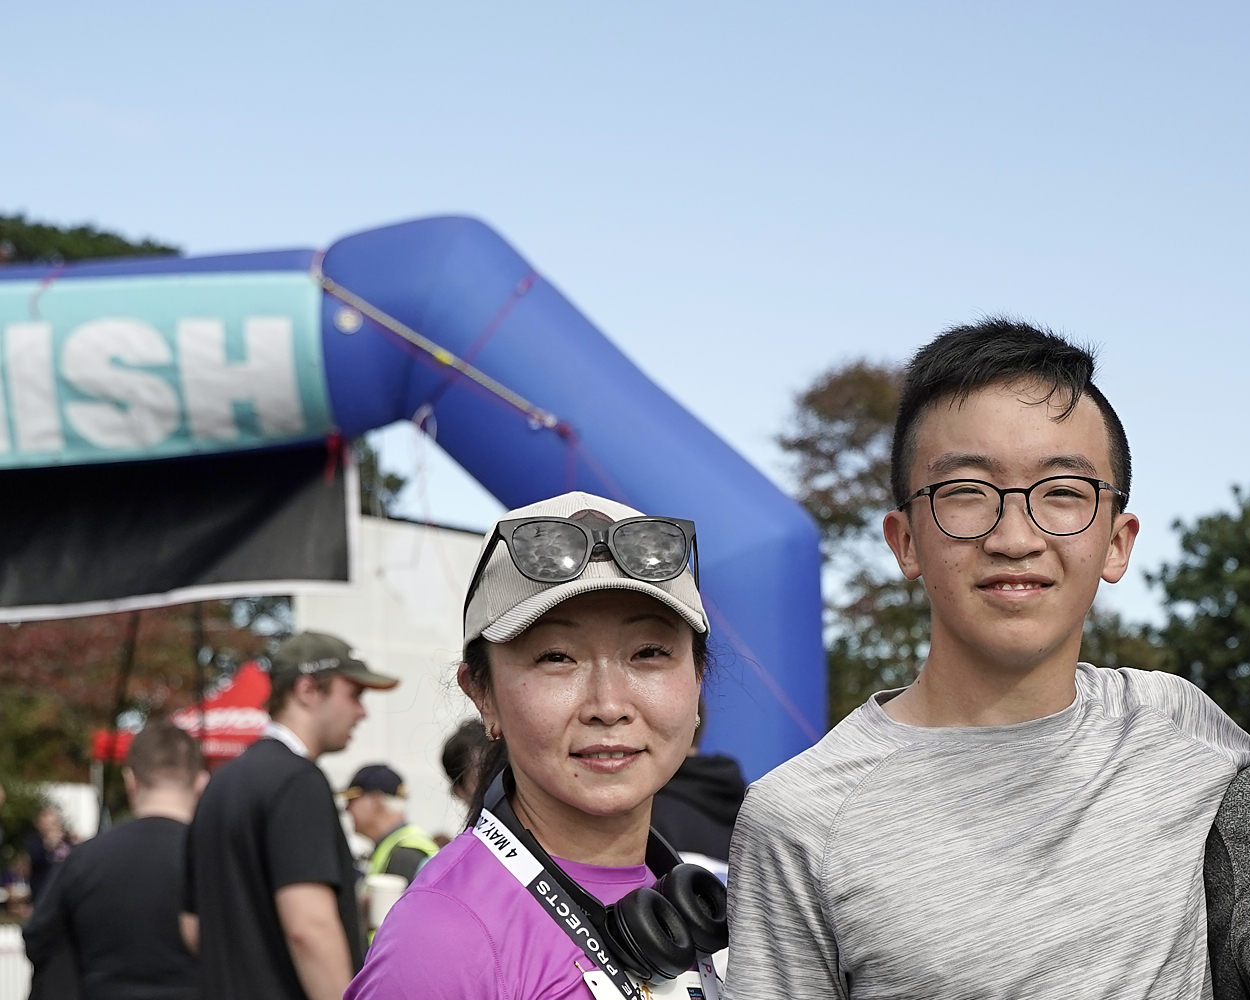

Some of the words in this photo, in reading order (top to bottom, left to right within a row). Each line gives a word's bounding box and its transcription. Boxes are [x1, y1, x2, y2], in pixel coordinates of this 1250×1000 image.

[0, 316, 305, 454] ISH
[482, 822, 511, 851] MAY,
[505, 847, 518, 858] 4
[535, 879, 619, 977] PROJECTS
